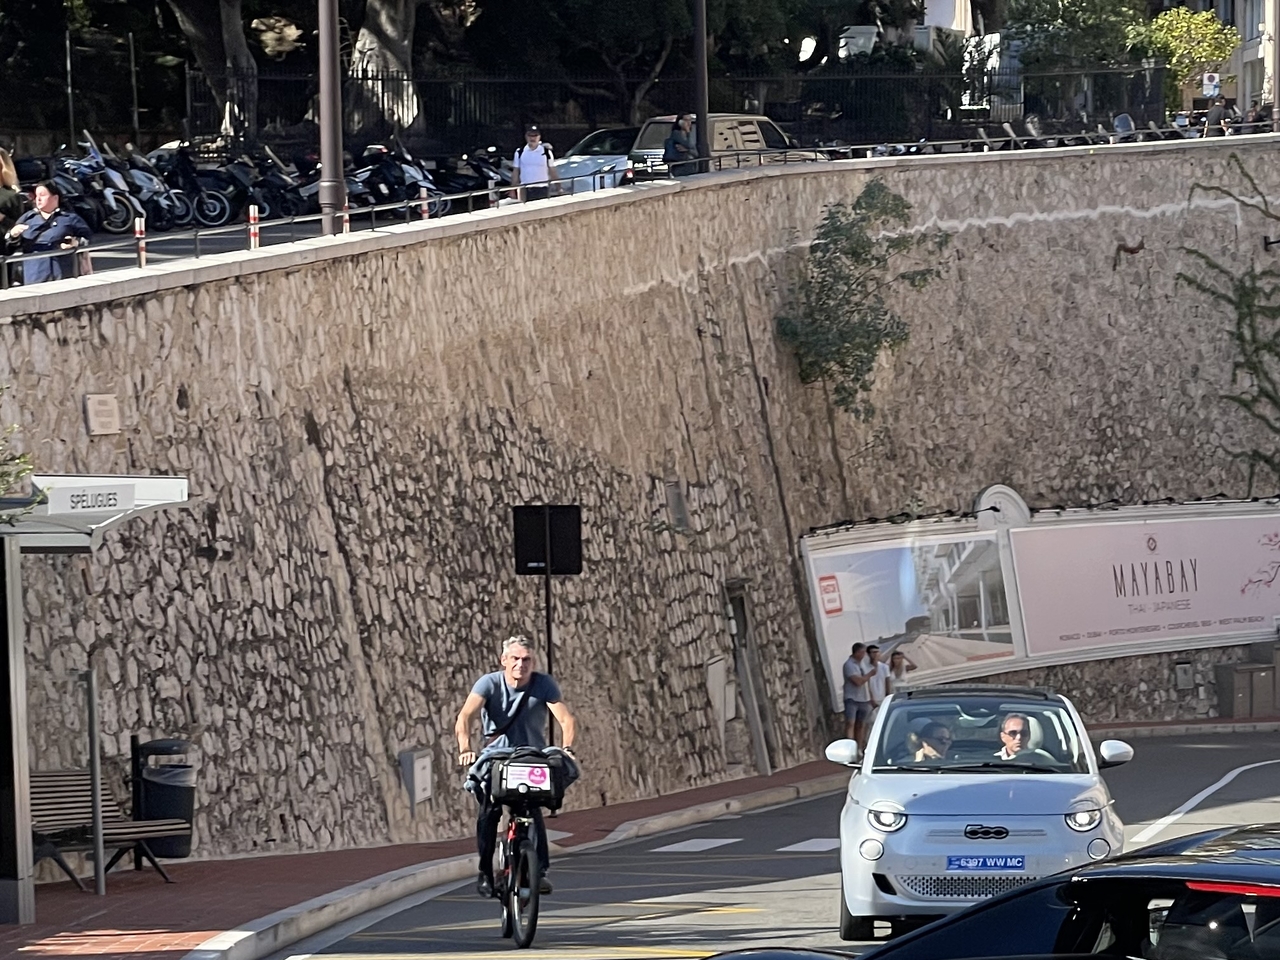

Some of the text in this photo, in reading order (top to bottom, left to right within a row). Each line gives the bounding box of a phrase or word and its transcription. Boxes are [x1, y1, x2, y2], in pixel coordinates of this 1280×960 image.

[70, 489, 118, 510] SPÉLUGUES
[1112, 558, 1198, 598] MAYABAY
[964, 824, 1009, 840] 500
[960, 858, 1023, 867] 6397 WW MC
